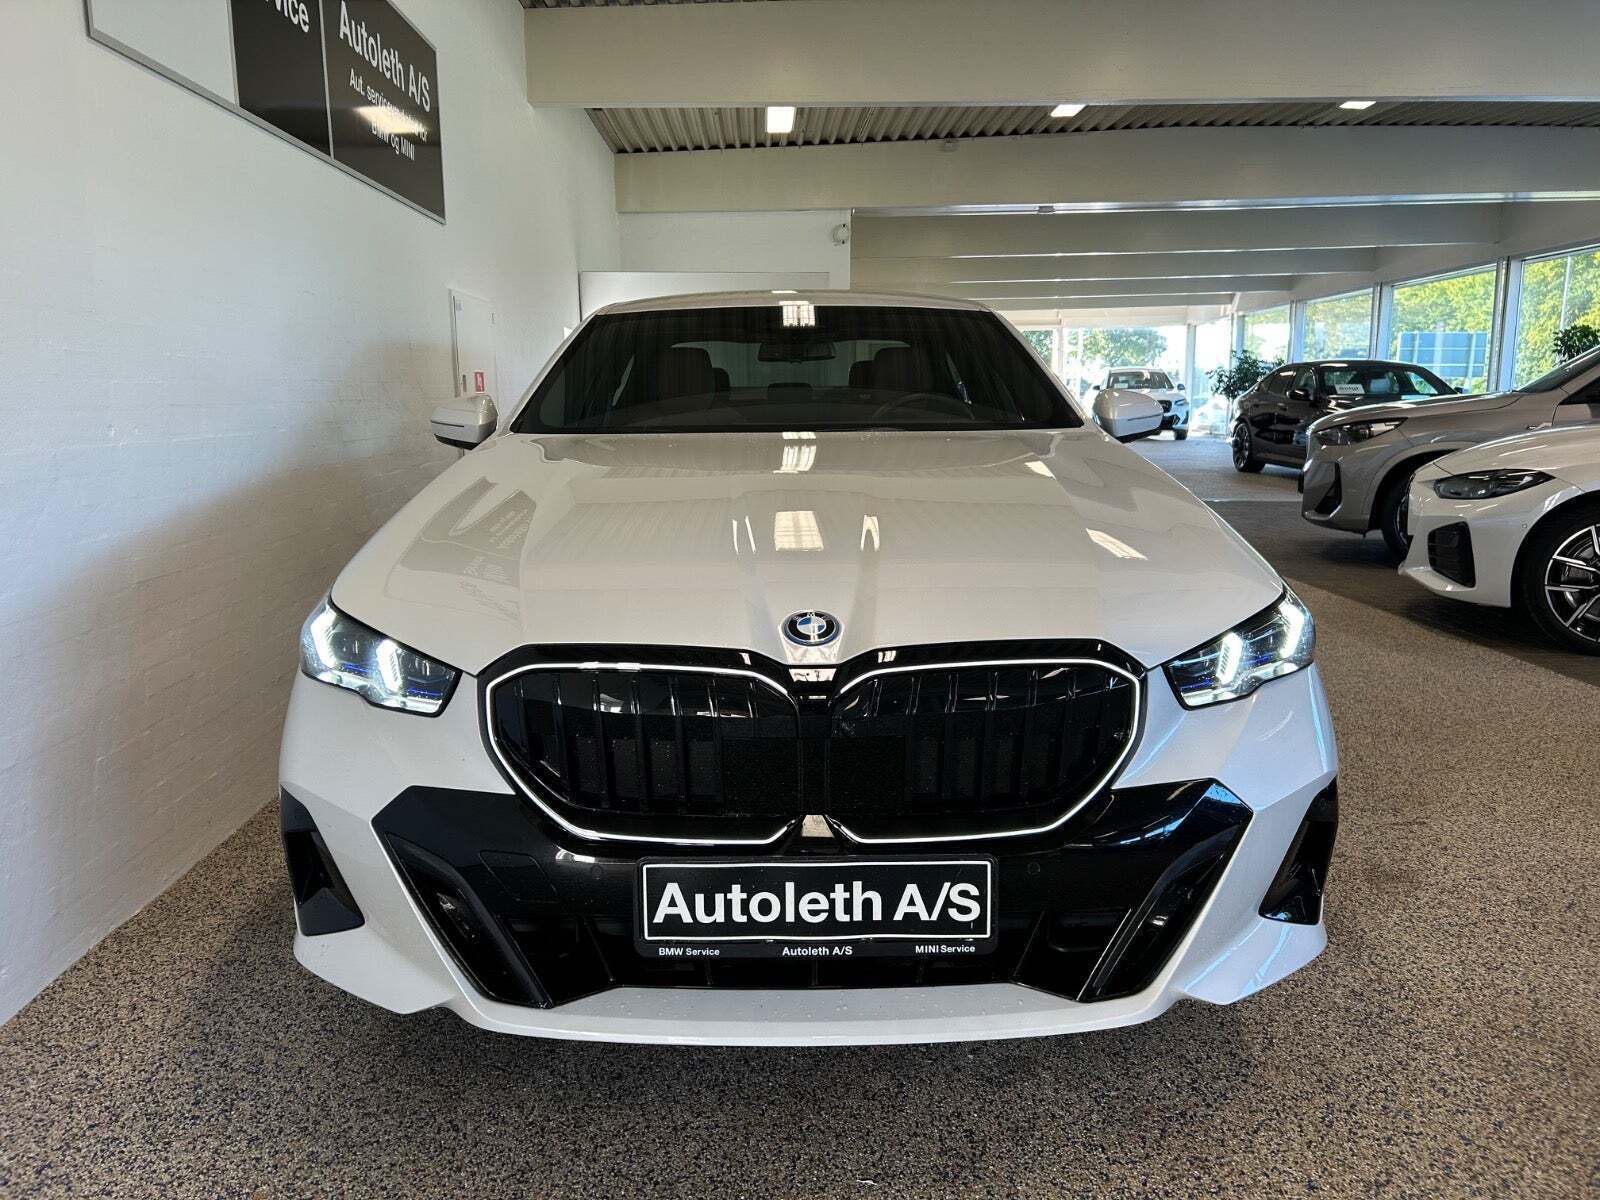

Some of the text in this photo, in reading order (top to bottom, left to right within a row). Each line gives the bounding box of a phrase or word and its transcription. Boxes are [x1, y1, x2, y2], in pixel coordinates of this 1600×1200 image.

[340, 0, 405, 92] Autoleth
[408, 63, 431, 113] A/S
[349, 68, 366, 97] Aut.
[400, 135, 416, 161] MINI
[652, 881, 982, 924] Autoleth A/S
[658, 947, 721, 957] BMW Service
[781, 945, 854, 957] Autoleth A/S
[914, 944, 976, 954] MINI Service
